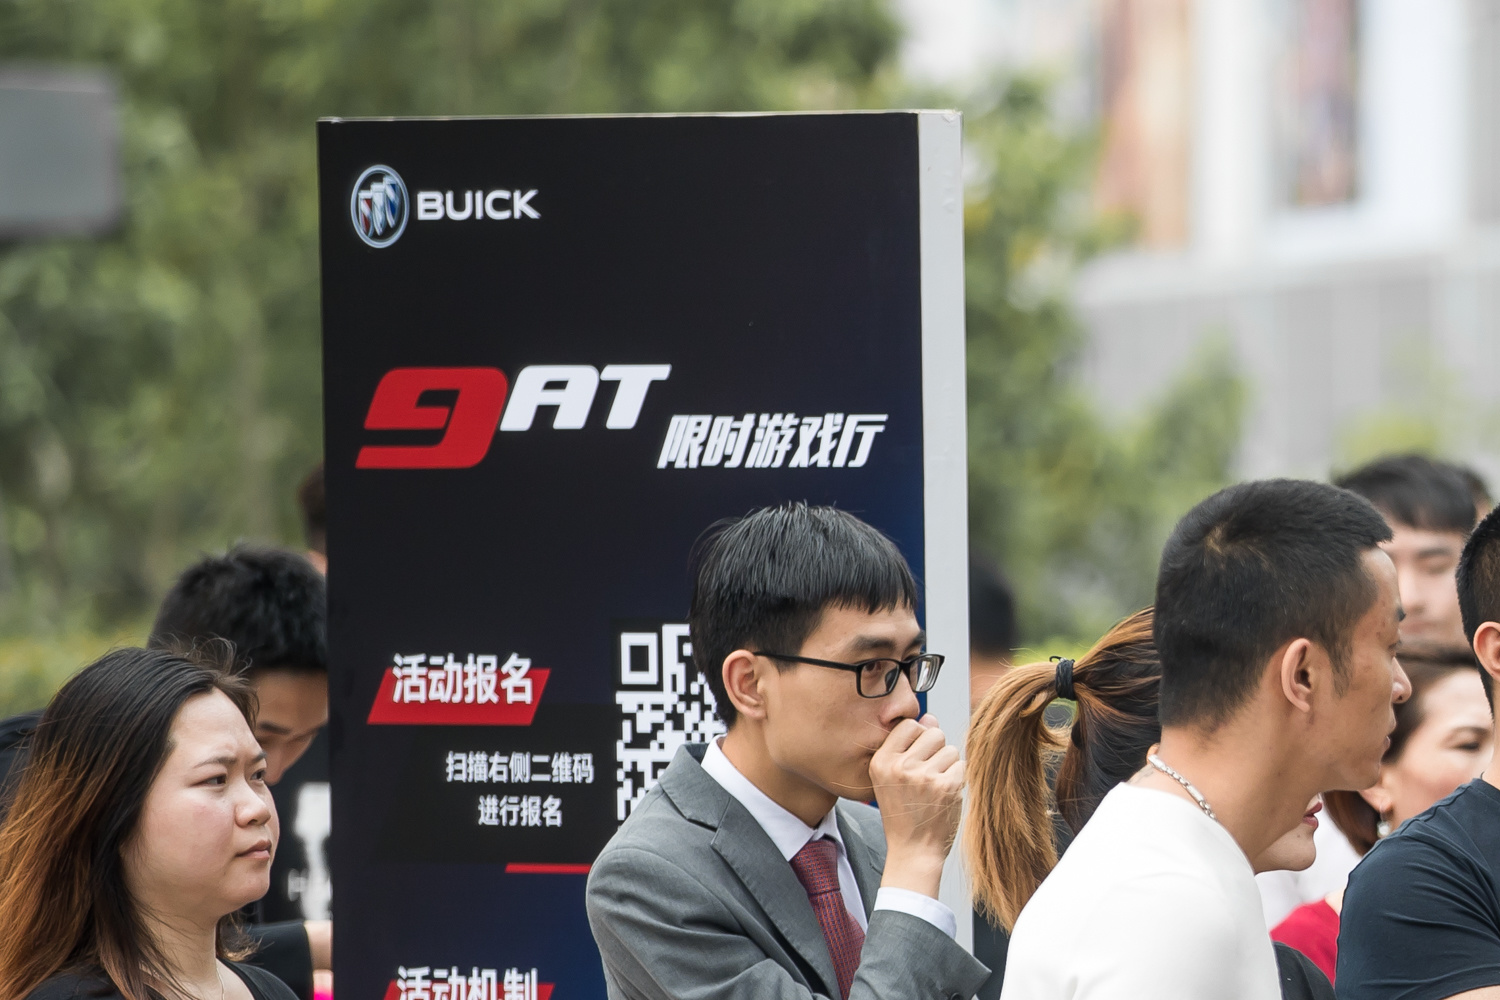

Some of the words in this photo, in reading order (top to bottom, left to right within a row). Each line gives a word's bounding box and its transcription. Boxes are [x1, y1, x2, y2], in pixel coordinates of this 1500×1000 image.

[417, 189, 541, 220] BUICK
[355, 365, 672, 469] 9AT
[657, 413, 888, 469] 限时游戏厅
[393, 653, 533, 705] 活动报名
[446, 751, 594, 784] 扫描右侧二维码
[478, 795, 562, 827] 进行报名
